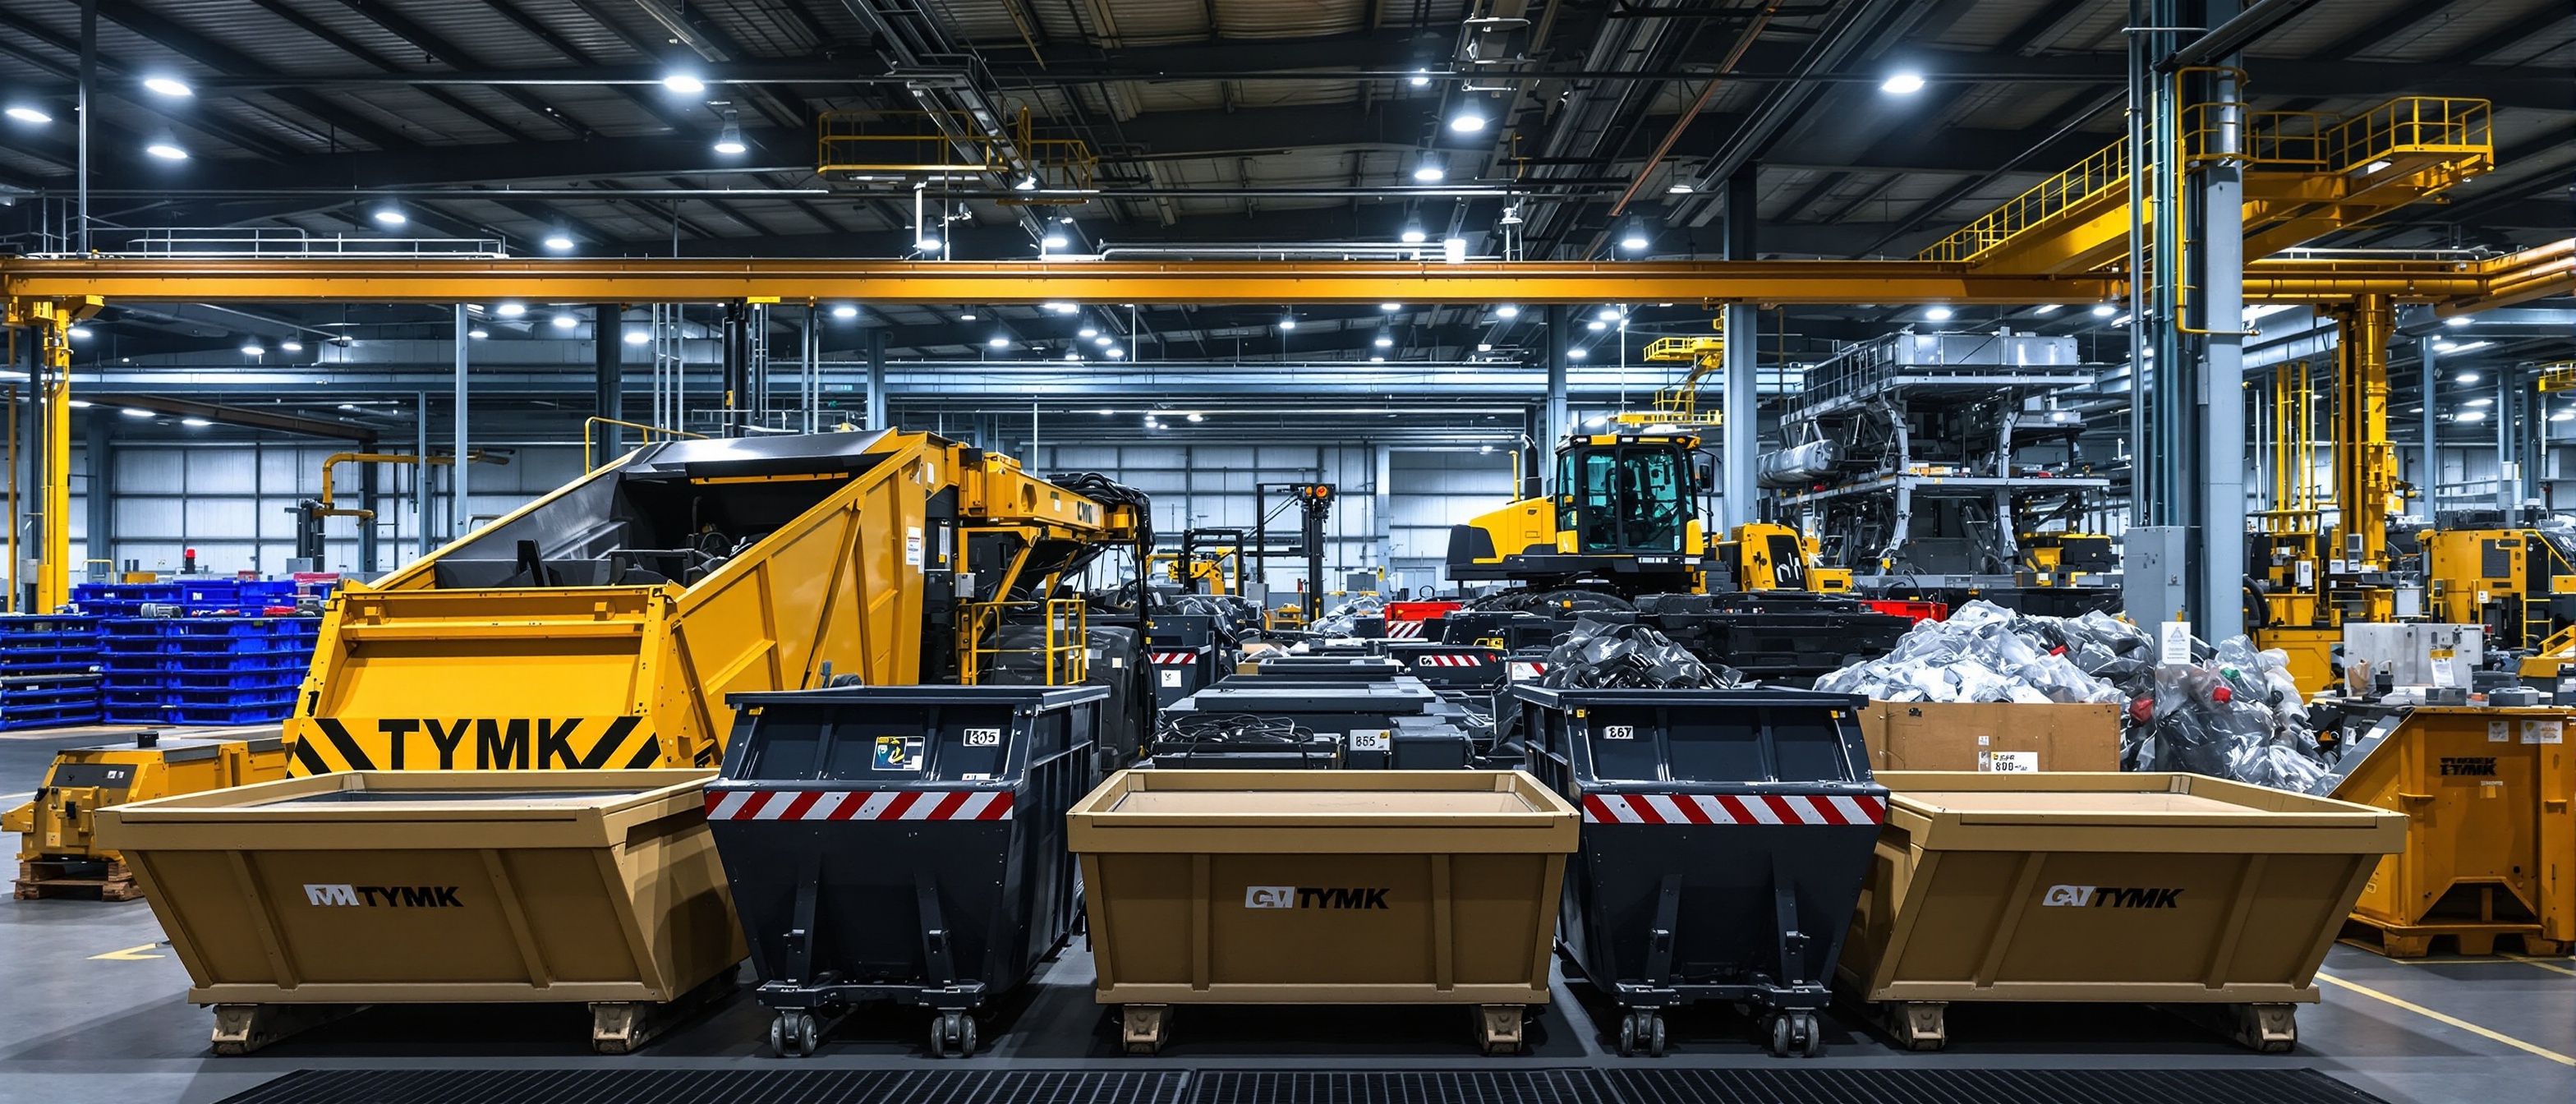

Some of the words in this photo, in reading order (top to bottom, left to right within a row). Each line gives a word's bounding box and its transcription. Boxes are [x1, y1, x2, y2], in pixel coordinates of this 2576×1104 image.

[378, 718, 585, 770] TYMK
[356, 886, 464, 907] TYMK
[1297, 888, 1390, 908] TYMK
[2095, 887, 2184, 908] TYMK
